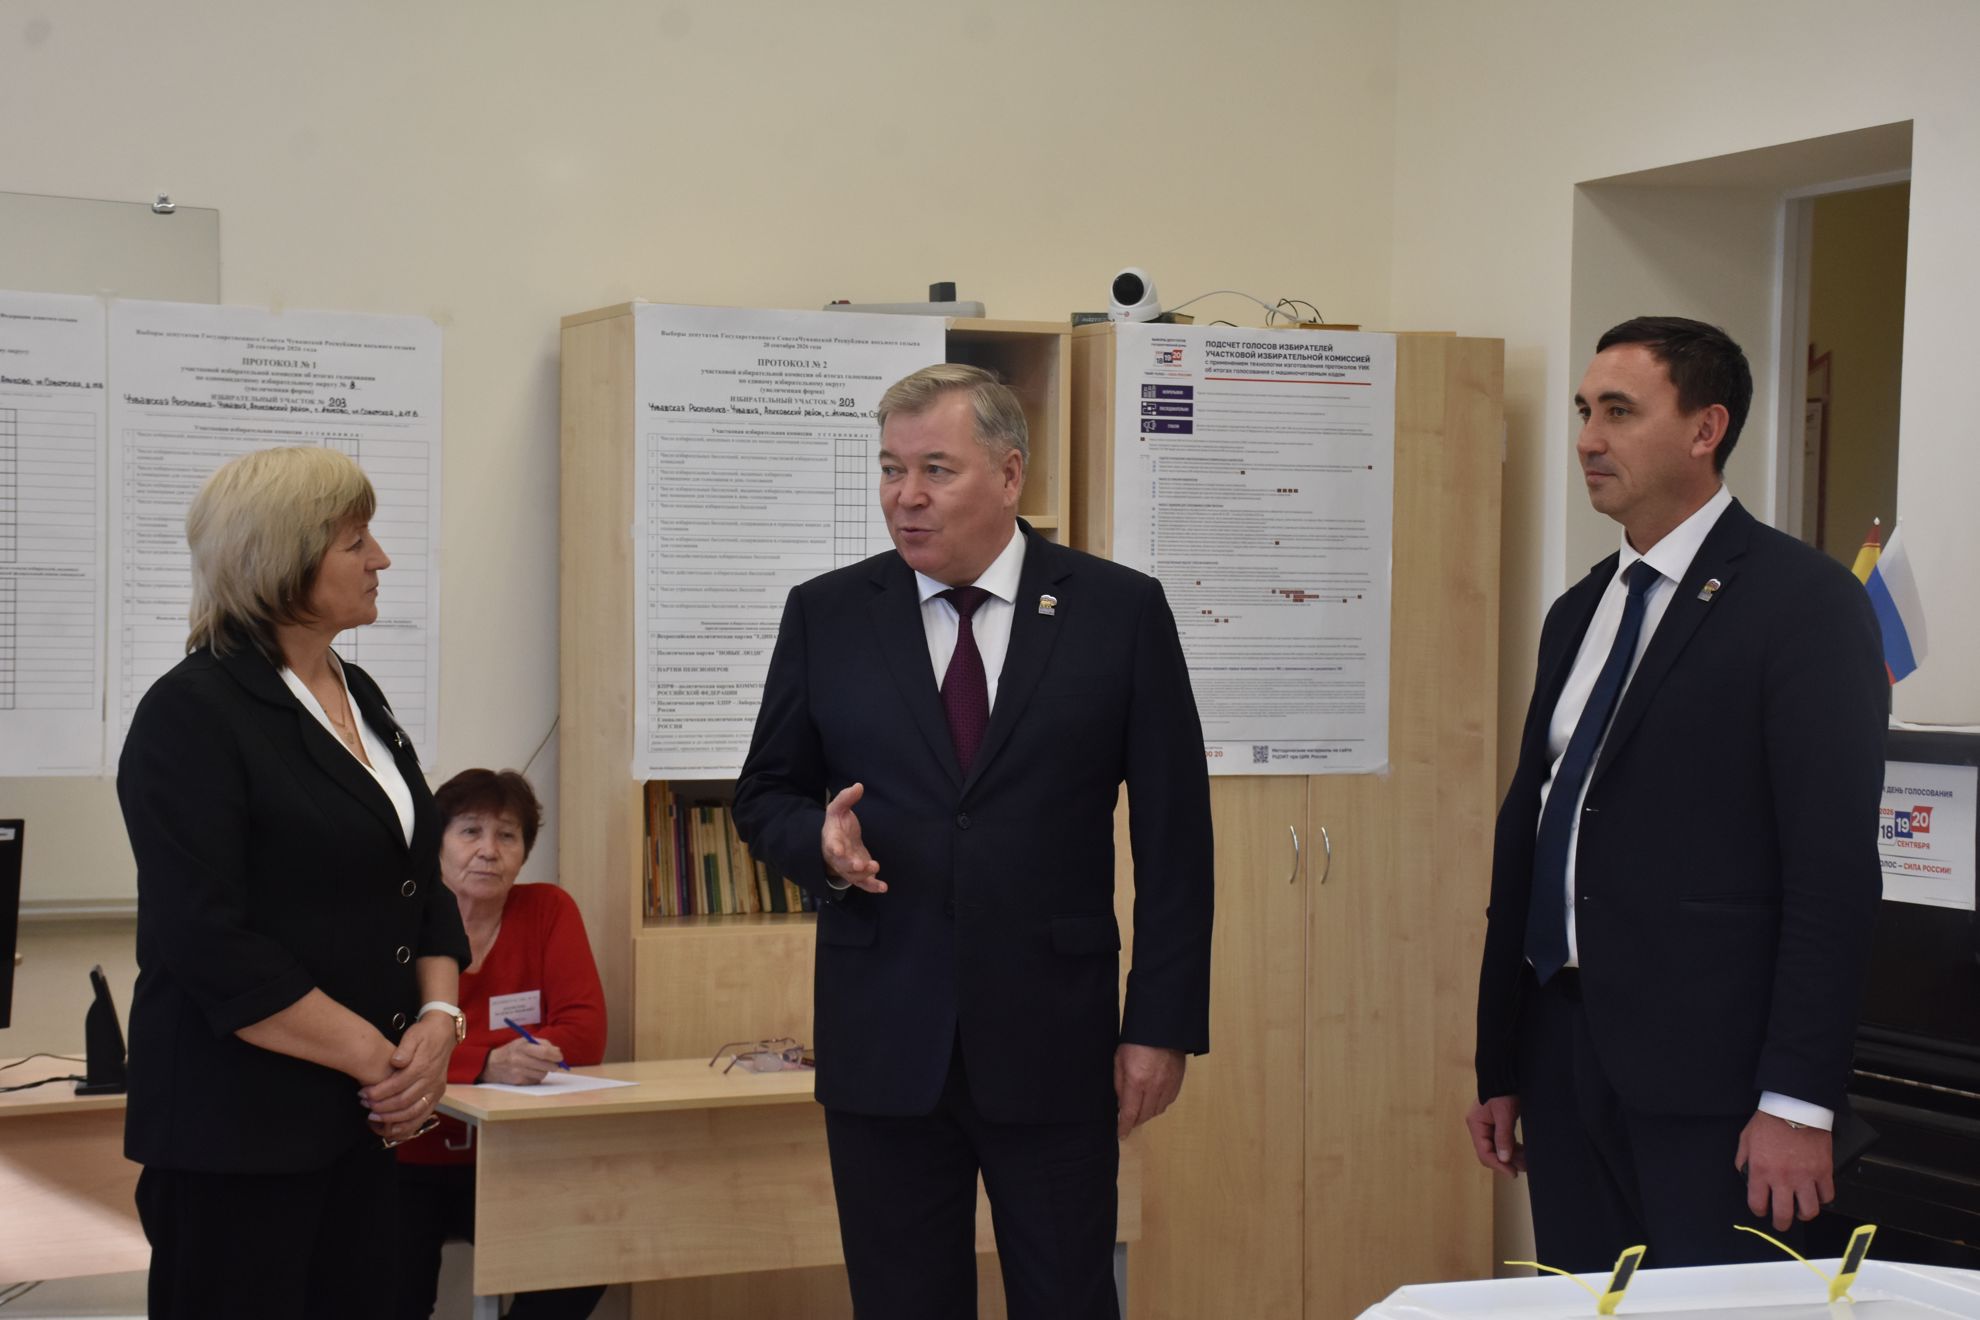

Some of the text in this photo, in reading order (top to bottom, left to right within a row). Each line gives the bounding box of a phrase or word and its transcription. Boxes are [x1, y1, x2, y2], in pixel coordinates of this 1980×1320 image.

[661, 330, 687, 338] Выборы
[834, 337, 869, 345] Республики
[325, 340, 362, 348] Республики
[1205, 340, 1333, 352] ПОДСЧЕТ ГОЛОСОВ ИЗБИРАТЕЛЕЙ
[242, 357, 298, 368] ПРОТОКОЛ
[1206, 350, 1370, 363] УЧАСТКОВОЙ ИЗБИРАТЕЛЬНОЙ КОМИССИЕЙ
[758, 358, 809, 368] ПРОТОКОЛ
[221, 368, 269, 376] избирательной
[701, 368, 736, 376] участковой
[211, 394, 278, 403] ИЗБИРАТЕЛЬНЫЙ
[280, 397, 315, 405] УЧАСТОК
[328, 397, 347, 408] 203
[730, 395, 793, 404] ИЗБИРАТЕЛЬНЫЙ
[838, 397, 855, 408] 203
[804, 409, 824, 418] район,
[1887, 786, 1953, 798] ДЕНЬ ГОЛОСОВАНИЯ
[1881, 811, 1928, 839] 18 19 20
[1897, 840, 1930, 849] СЕНТЯБРЯ
[1880, 860, 1897, 868] ОЛОС
[1904, 863, 1921, 871] СИЛА
[1923, 865, 1952, 874] РОССИИ!
